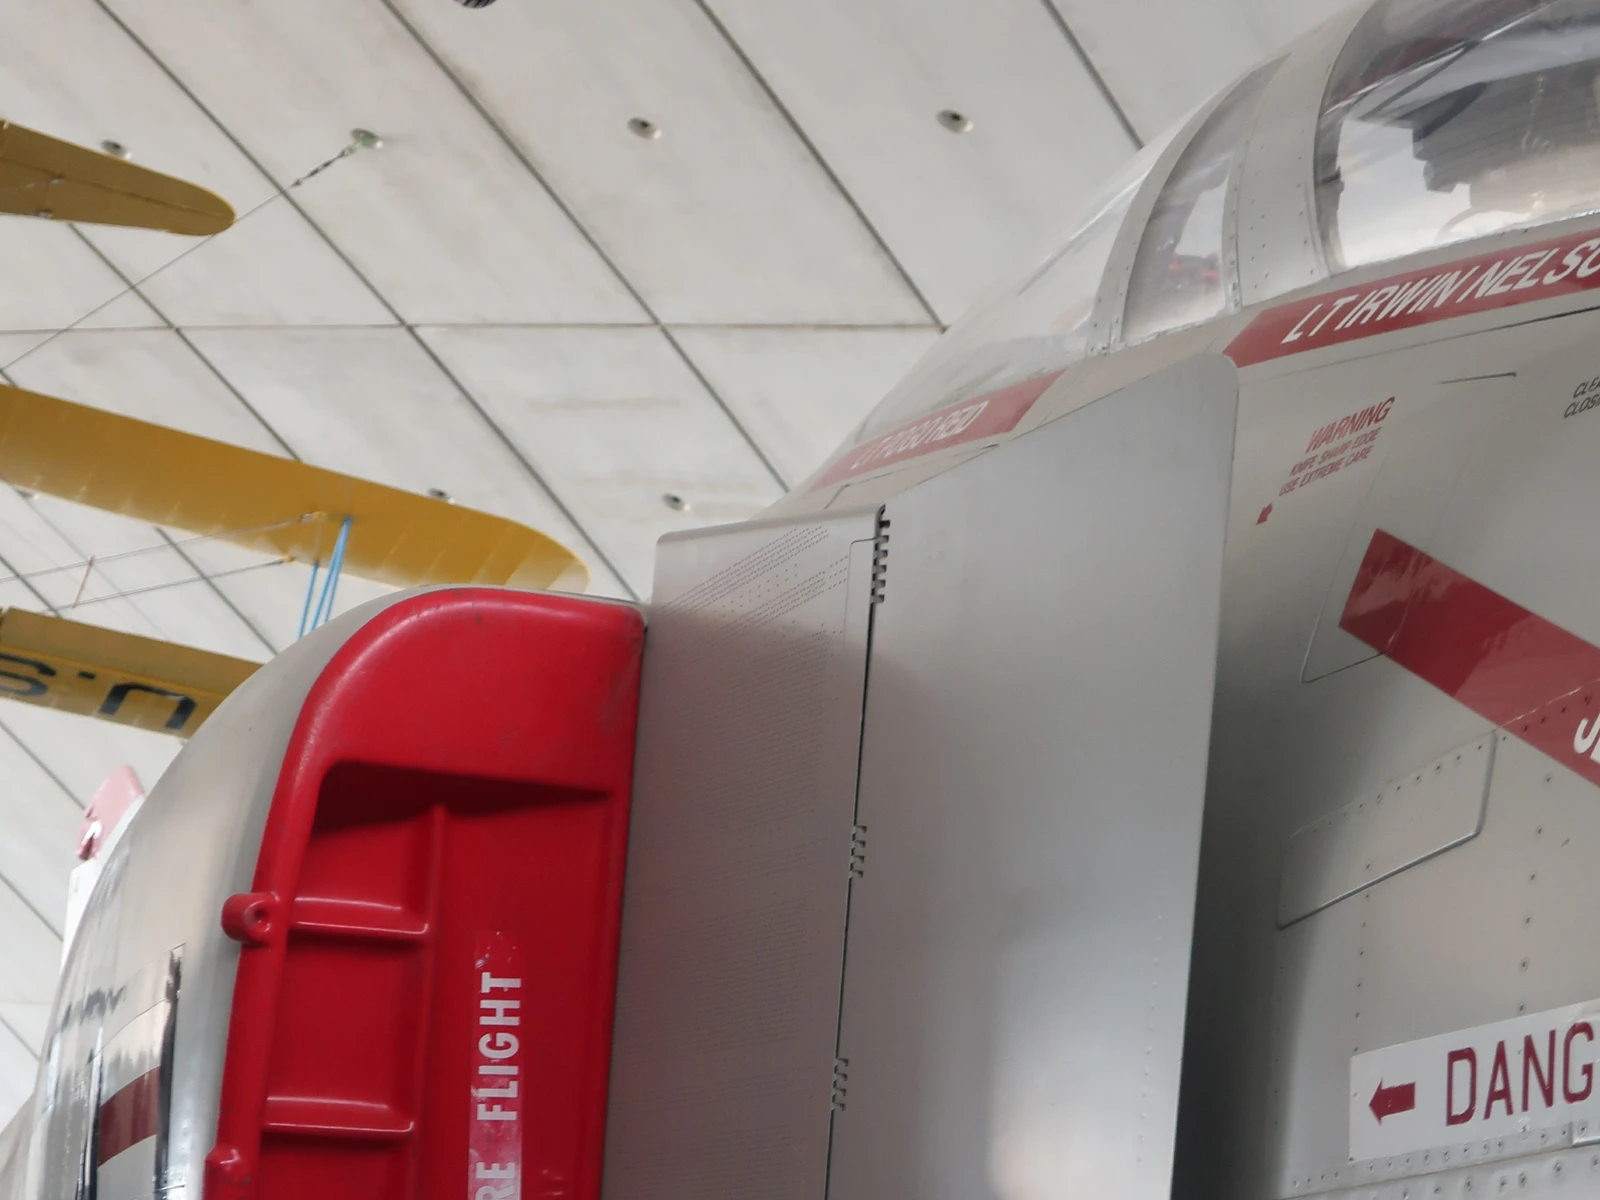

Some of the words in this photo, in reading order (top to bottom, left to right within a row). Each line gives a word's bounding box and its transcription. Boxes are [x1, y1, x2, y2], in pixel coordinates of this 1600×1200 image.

[1281, 294, 1356, 344] LT
[1334, 265, 1480, 331] IRWIN
[1573, 376, 1600, 398] CLE
[1305, 396, 1395, 454] WARNING
[1351, 426, 1382, 449] EDGE
[1278, 476, 1300, 497] USE
[1298, 457, 1346, 489] EXTREME
[1344, 444, 1374, 467] CARE
[476, 972, 521, 1121] FLIGHT
[1446, 1022, 1595, 1127] DANG
